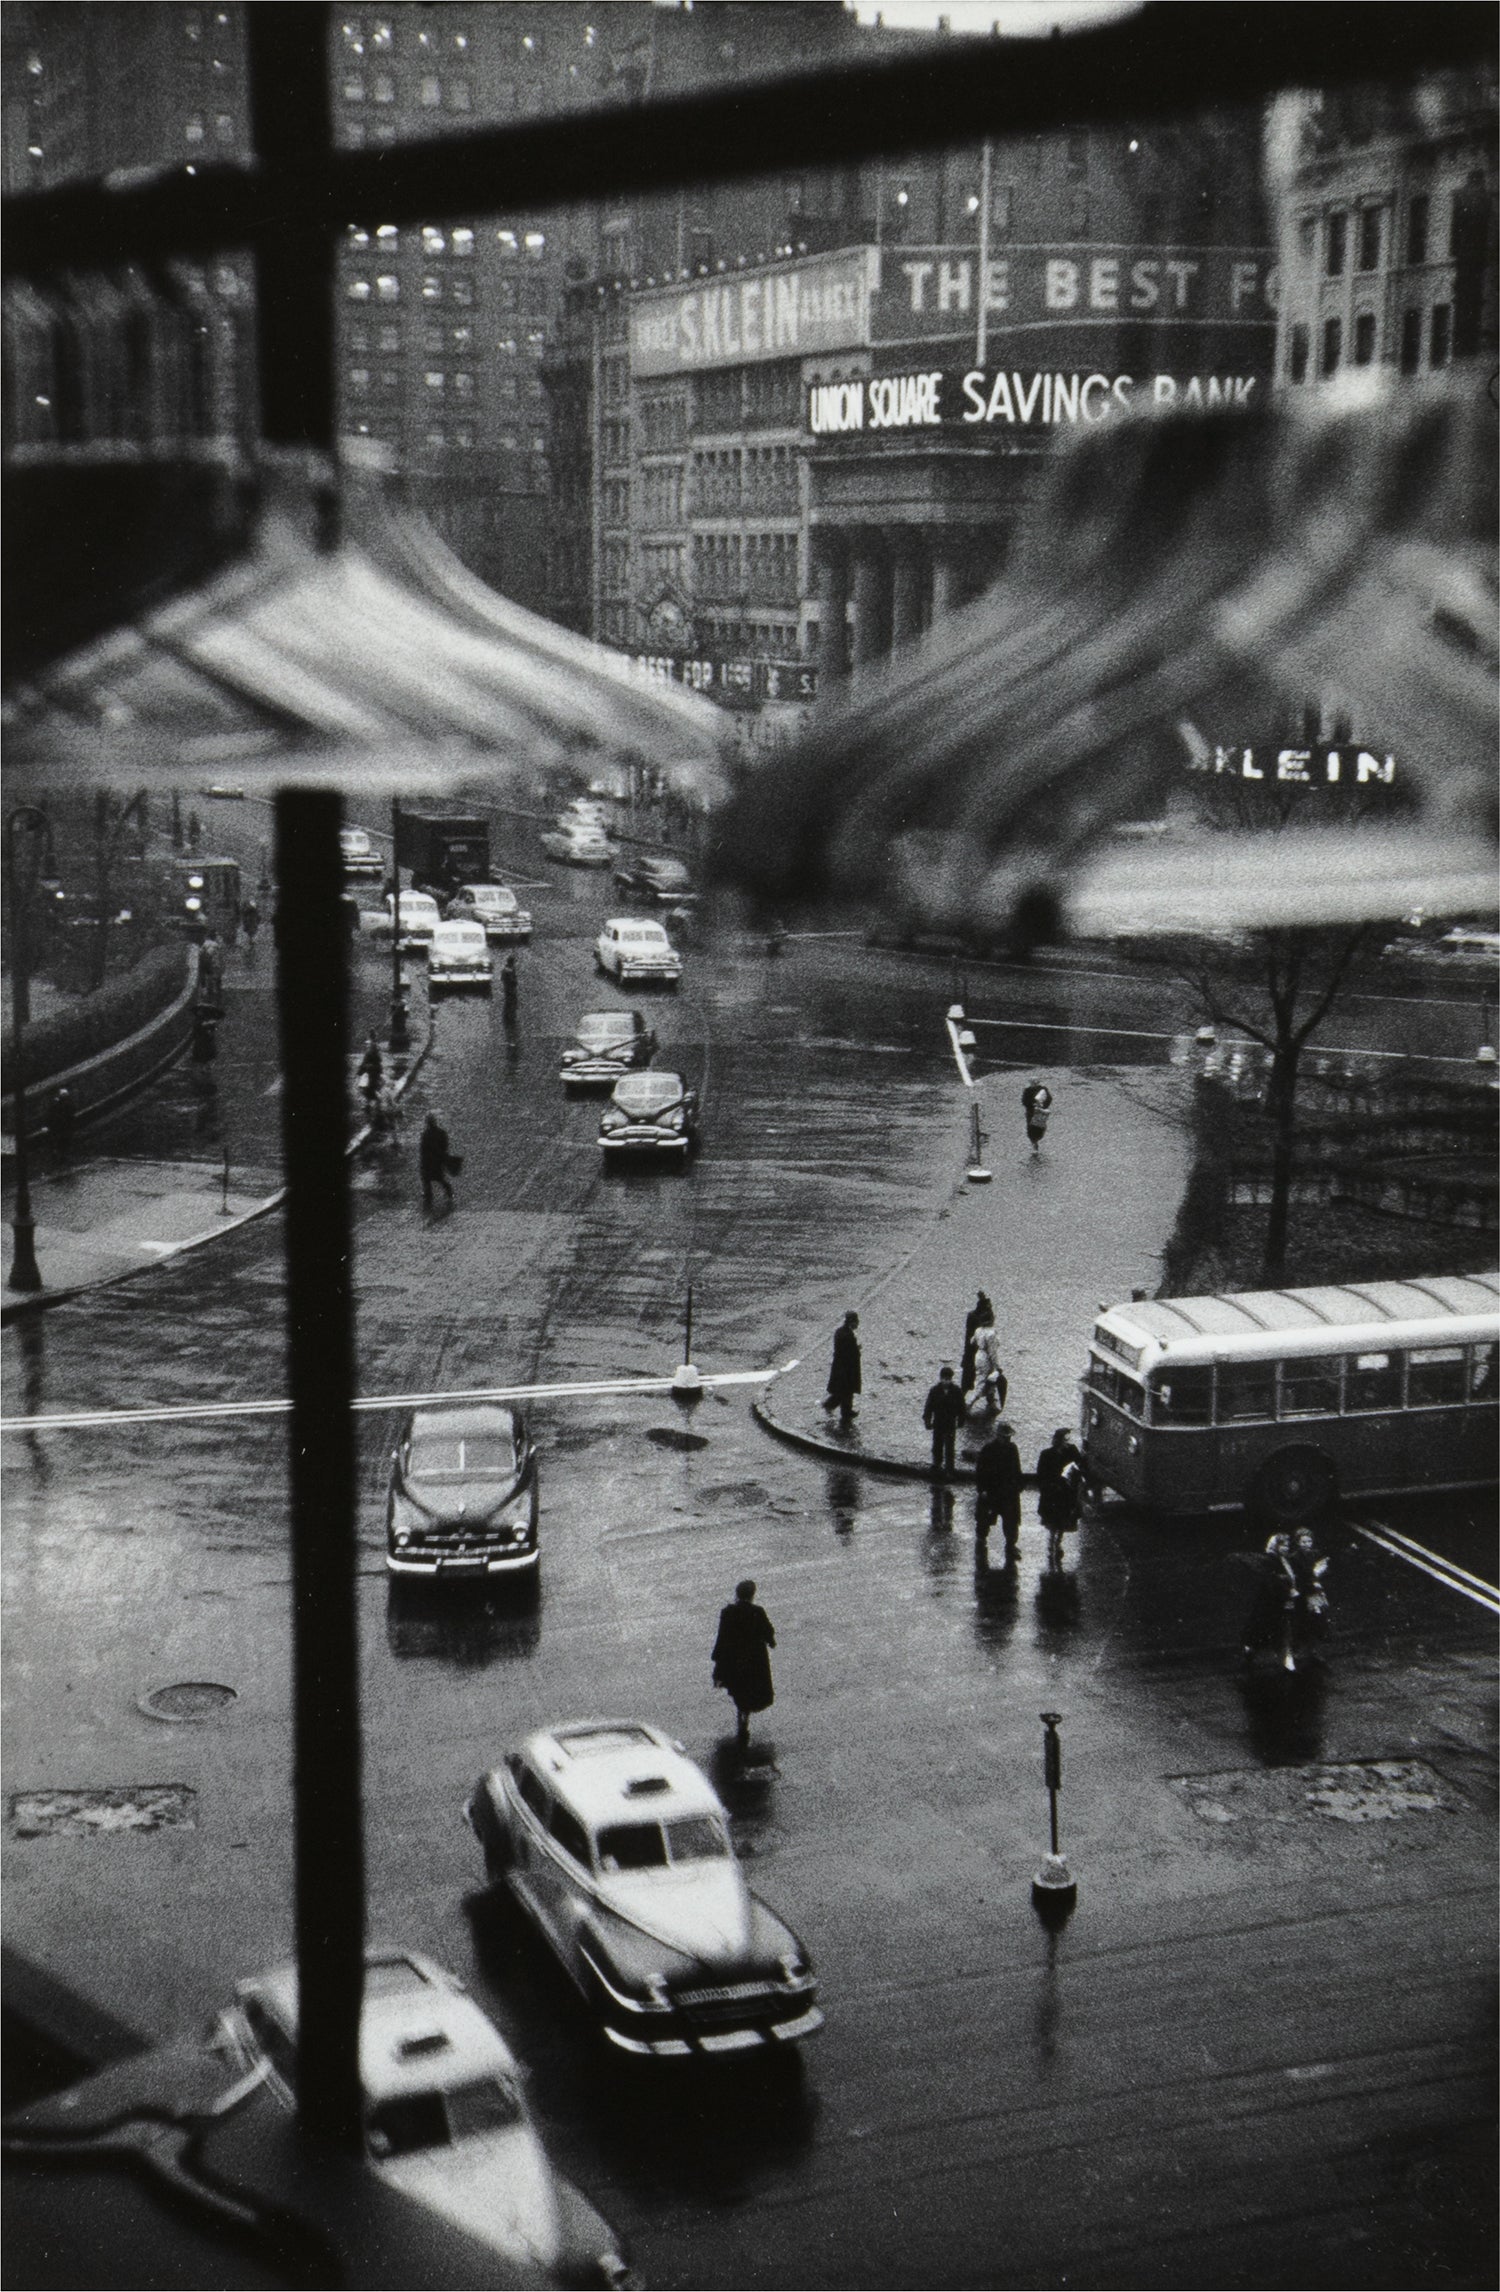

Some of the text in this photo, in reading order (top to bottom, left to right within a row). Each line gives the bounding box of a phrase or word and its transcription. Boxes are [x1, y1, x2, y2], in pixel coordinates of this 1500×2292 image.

[902, 259, 1010, 312] THE
[1045, 257, 1200, 310] BEST
[811, 382, 864, 433] UNION
[868, 371, 943, 428] SQUARE
[962, 371, 1133, 424] SAVINGS
[1215, 745, 1395, 783] KLEIN
